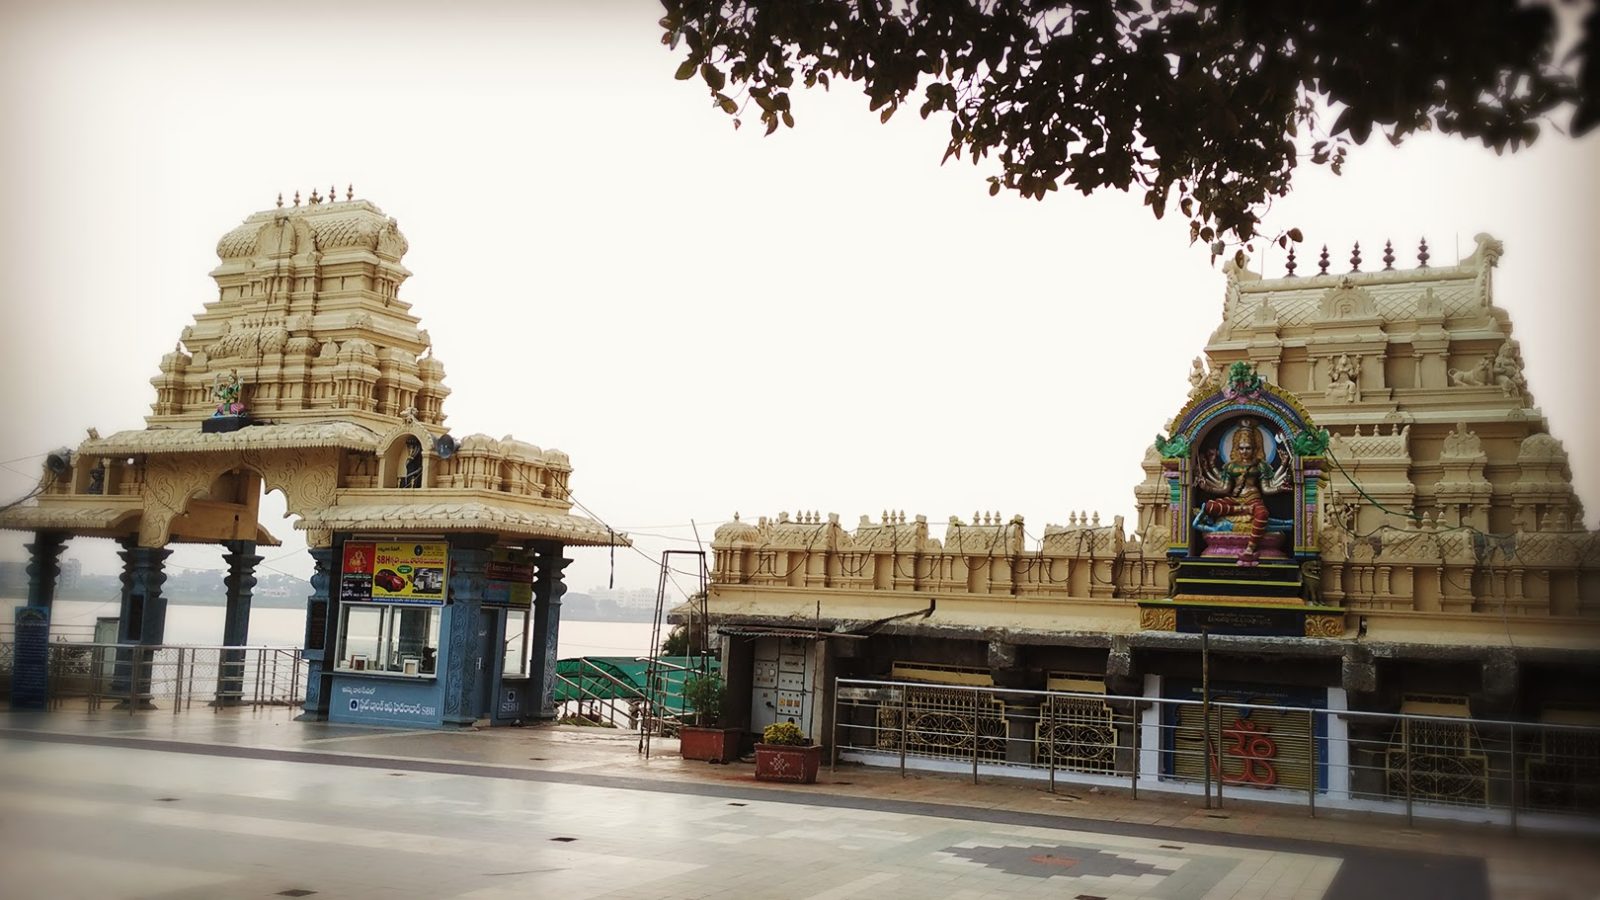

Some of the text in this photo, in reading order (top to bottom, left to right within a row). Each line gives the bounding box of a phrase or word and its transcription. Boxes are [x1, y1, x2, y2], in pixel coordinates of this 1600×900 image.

[377, 555, 390, 565] SBH
[421, 706, 436, 716] SBH
[502, 702, 519, 712] SBH
